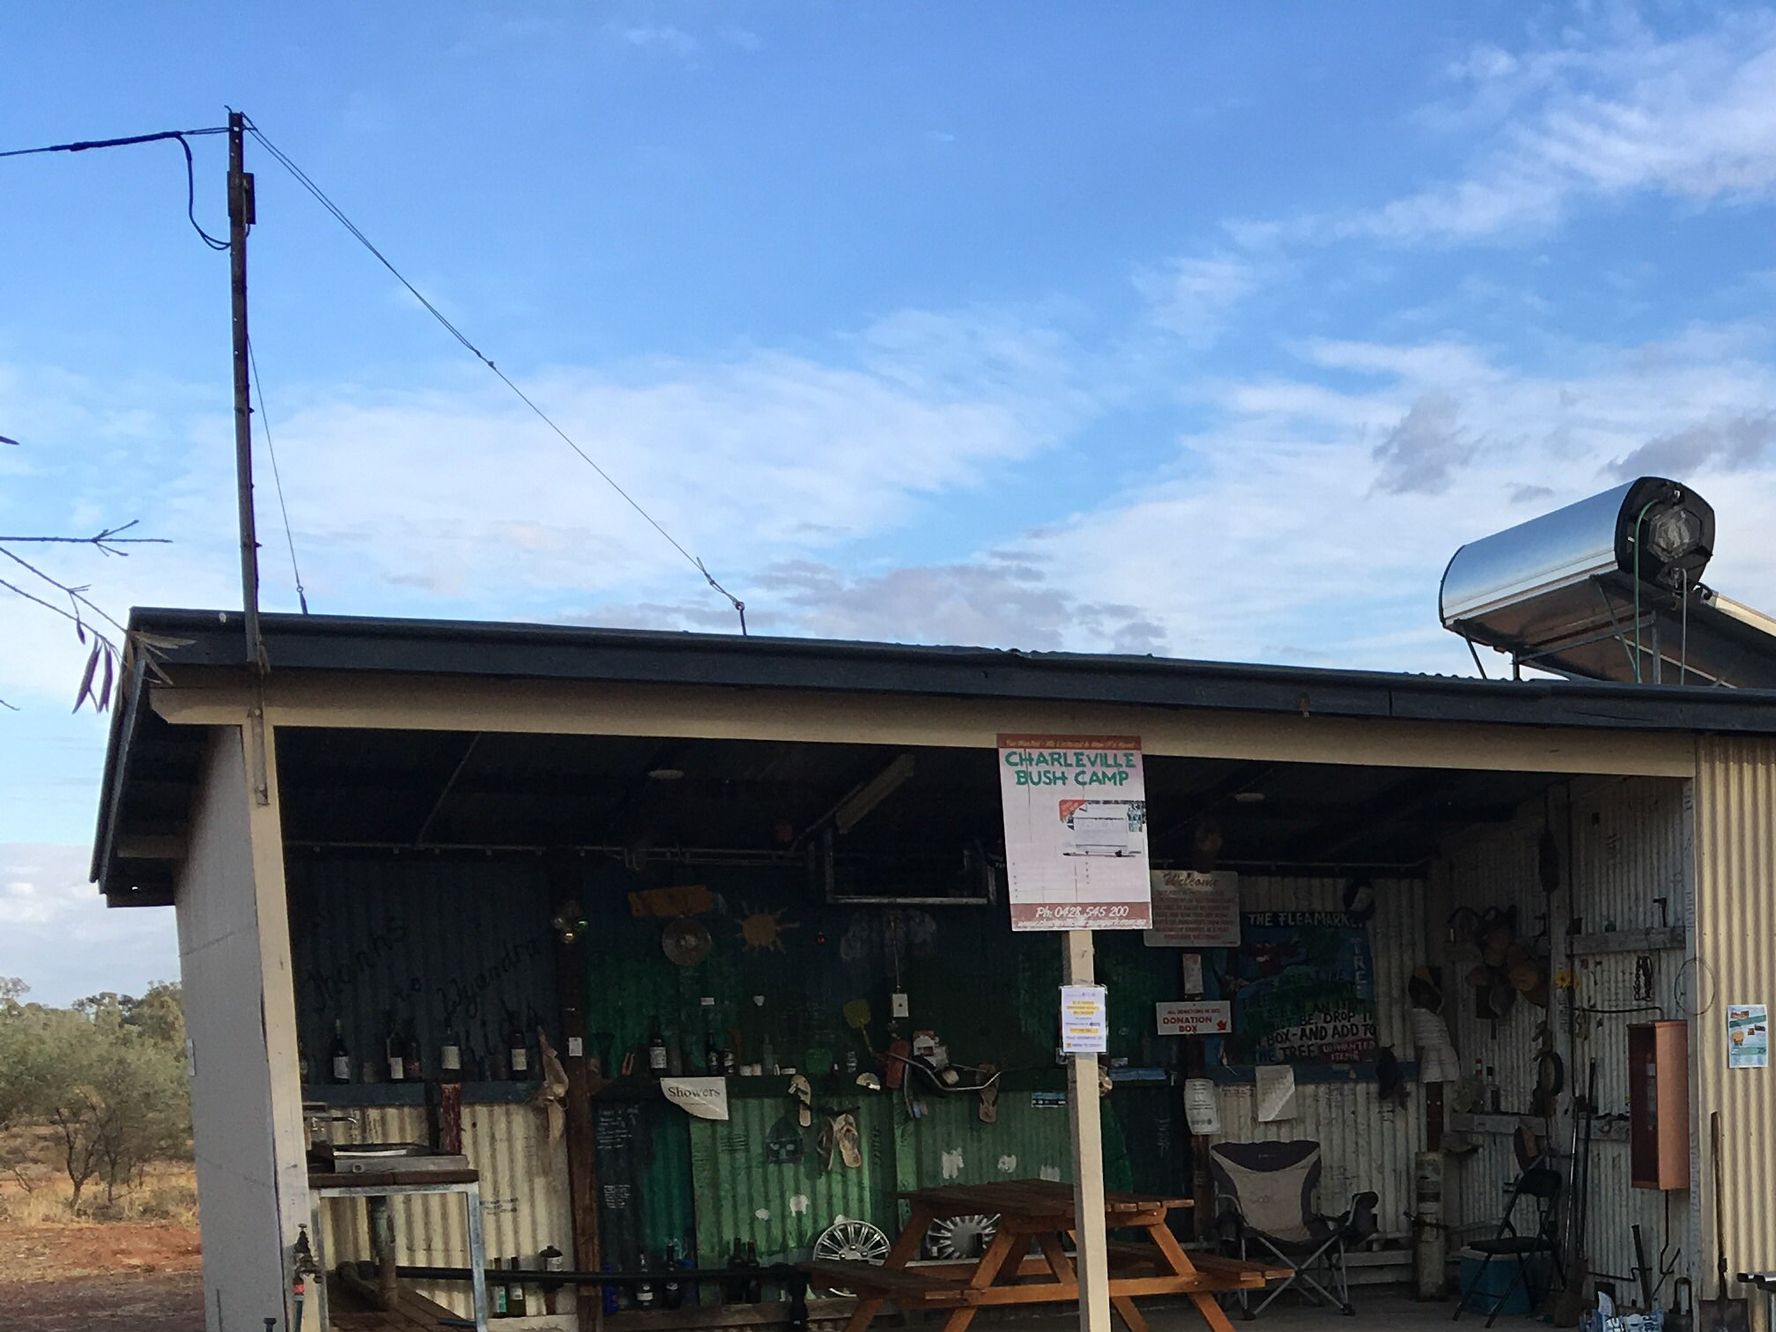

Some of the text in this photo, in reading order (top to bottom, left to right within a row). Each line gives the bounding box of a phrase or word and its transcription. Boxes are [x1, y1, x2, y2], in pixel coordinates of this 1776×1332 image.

[1004, 751, 1136, 768] CHARLEVILLE
[1015, 770, 1129, 786] BUSH CAMP
[1054, 906, 1081, 918] 0428
[1084, 906, 1107, 917] 545
[1108, 905, 1129, 917] 200
[1248, 912, 1363, 928] THE FLEAMARK
[1163, 1016, 1212, 1025] DONATION
[1323, 1010, 1355, 1024] DROP
[1178, 1024, 1197, 1032] BOX
[1331, 1023, 1359, 1038] ADD
[1279, 1044, 1315, 1058] TREE
[667, 1086, 720, 1098] Showers
